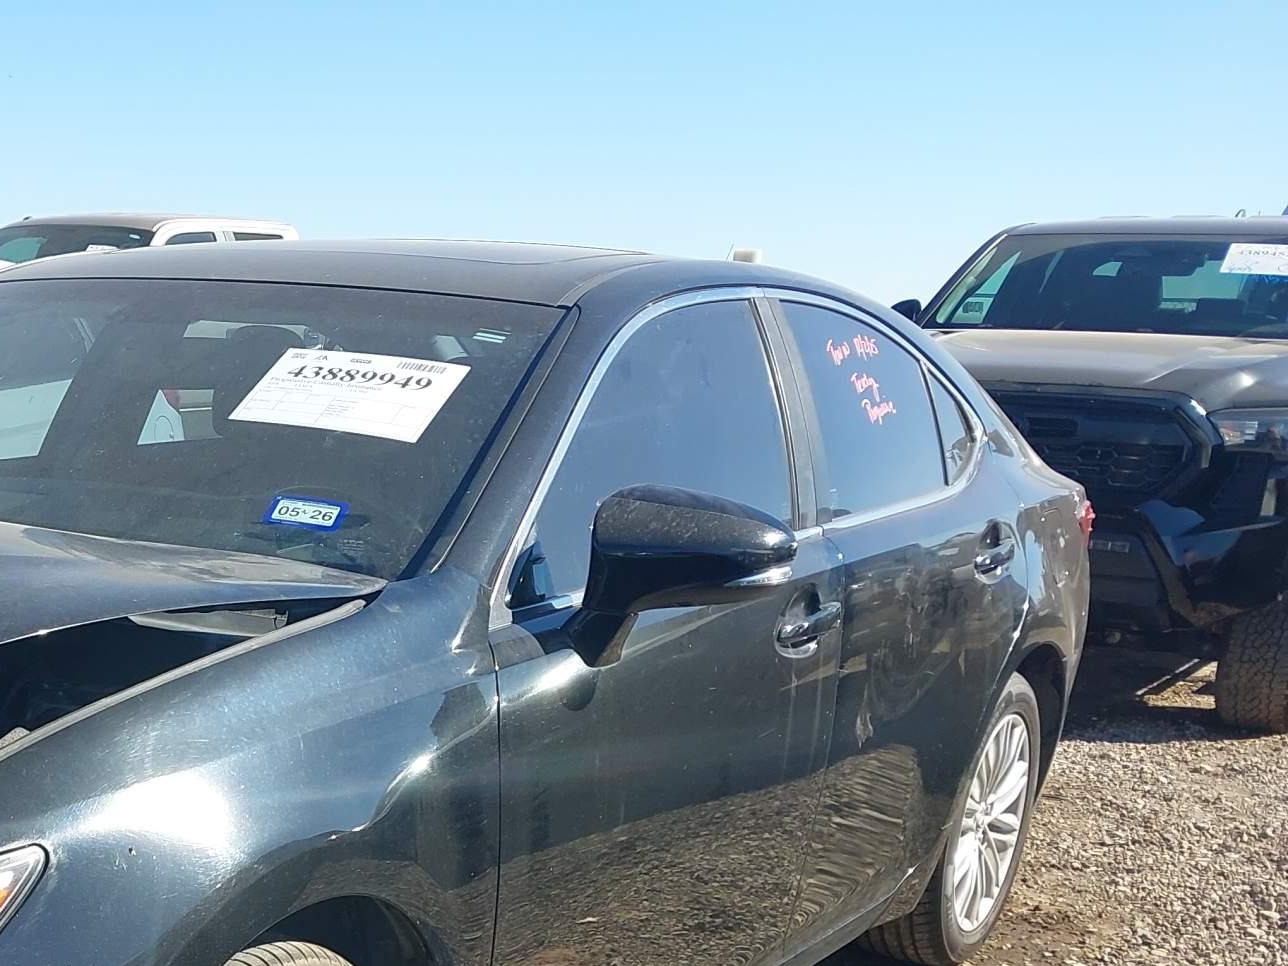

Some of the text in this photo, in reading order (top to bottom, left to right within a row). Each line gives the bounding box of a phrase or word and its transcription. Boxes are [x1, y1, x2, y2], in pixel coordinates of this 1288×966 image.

[287, 365, 433, 391] 43889949
[277, 505, 335, 522] 05 26
